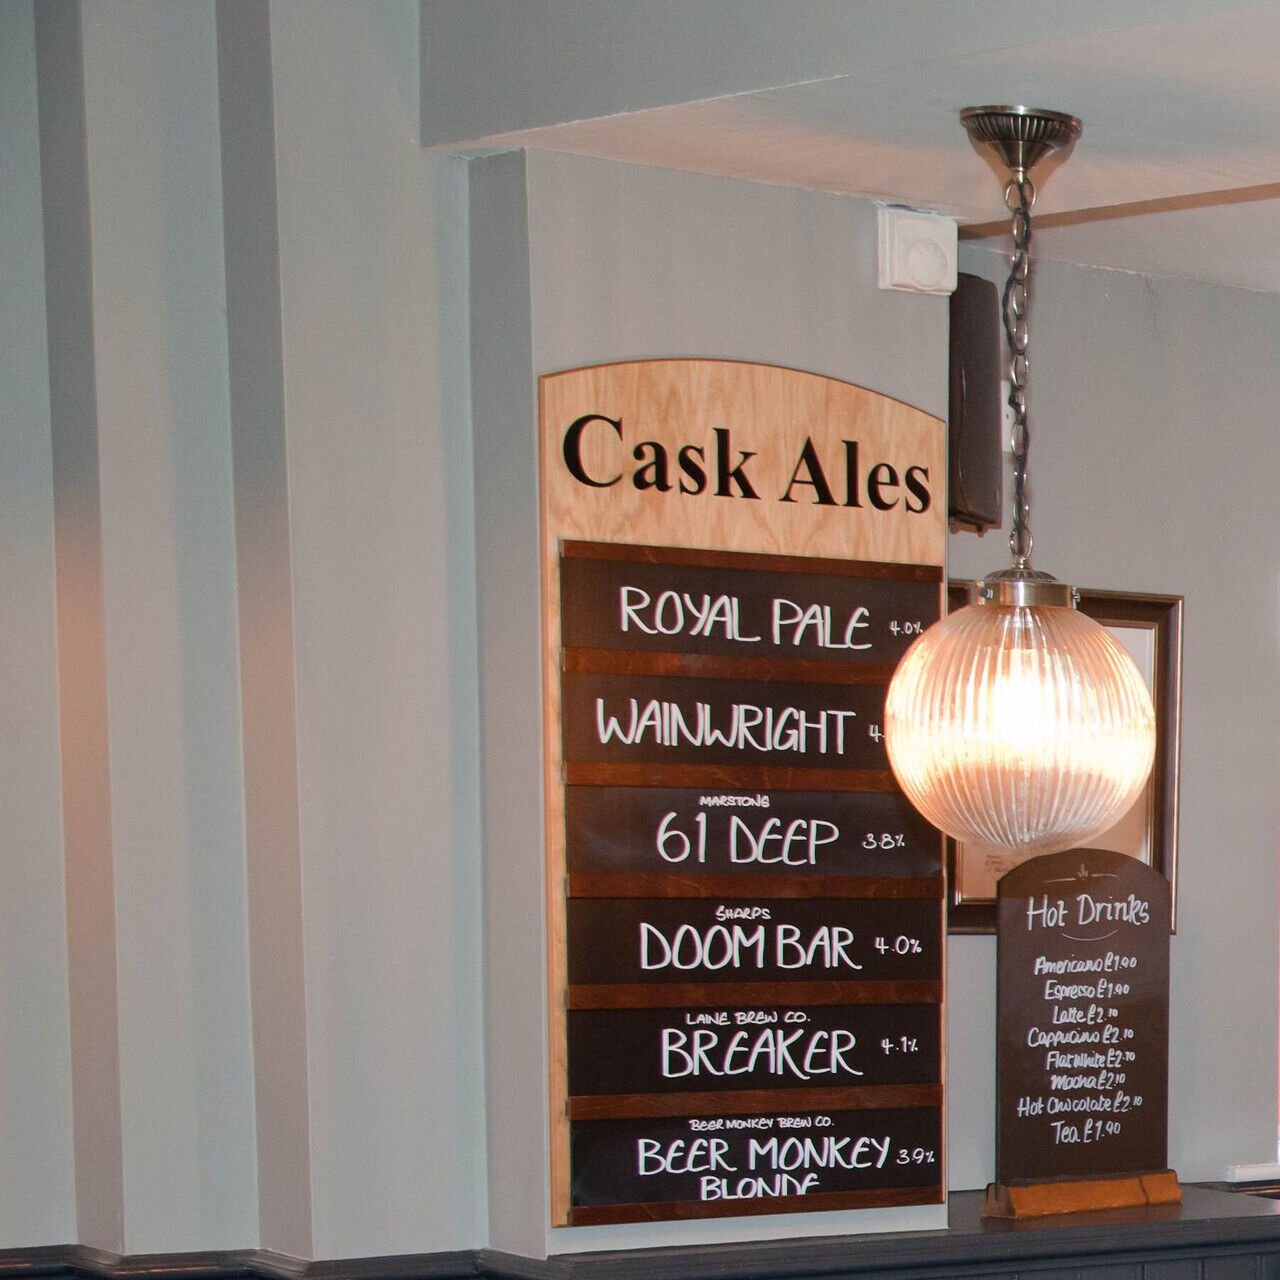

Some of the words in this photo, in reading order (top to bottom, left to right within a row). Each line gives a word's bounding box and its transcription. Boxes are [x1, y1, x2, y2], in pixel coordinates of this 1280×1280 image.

[562, 413, 762, 502] Cask
[779, 435, 932, 514] Ales
[620, 585, 762, 643] ROYAL
[770, 598, 873, 651] PALE
[596, 697, 856, 755] WAINWRIGHT
[699, 794, 770, 808] MARSTONS
[656, 811, 707, 863] 61
[729, 814, 840, 865] DEEP
[715, 905, 773, 921] SHARPS
[1026, 893, 1068, 931] Hot
[1077, 893, 1151, 926] Drinks
[639, 921, 765, 970] DOOM
[775, 923, 864, 970] BAR
[874, 935, 923, 955] 4.0%
[1034, 953, 1103, 975] Americano
[1044, 979, 1096, 1001] Espresso
[686, 1012, 732, 1026] LAINE
[734, 1010, 779, 1025] BREW
[784, 1011, 812, 1023] CO.
[1052, 1005, 1087, 1025] Latte
[661, 1028, 864, 1080] BREAKER
[880, 1036, 919, 1055] 4.1%
[1046, 1050, 1073, 1071] Flat
[1016, 1096, 1045, 1118] Hot
[688, 1119, 724, 1131] BEER
[726, 1118, 774, 1129] MONKEY
[776, 1116, 812, 1129] BREW
[814, 1115, 836, 1127] CO.
[1050, 1120, 1082, 1145] Tea
[638, 1138, 738, 1176] BEER
[749, 1136, 891, 1170] MONKEY
